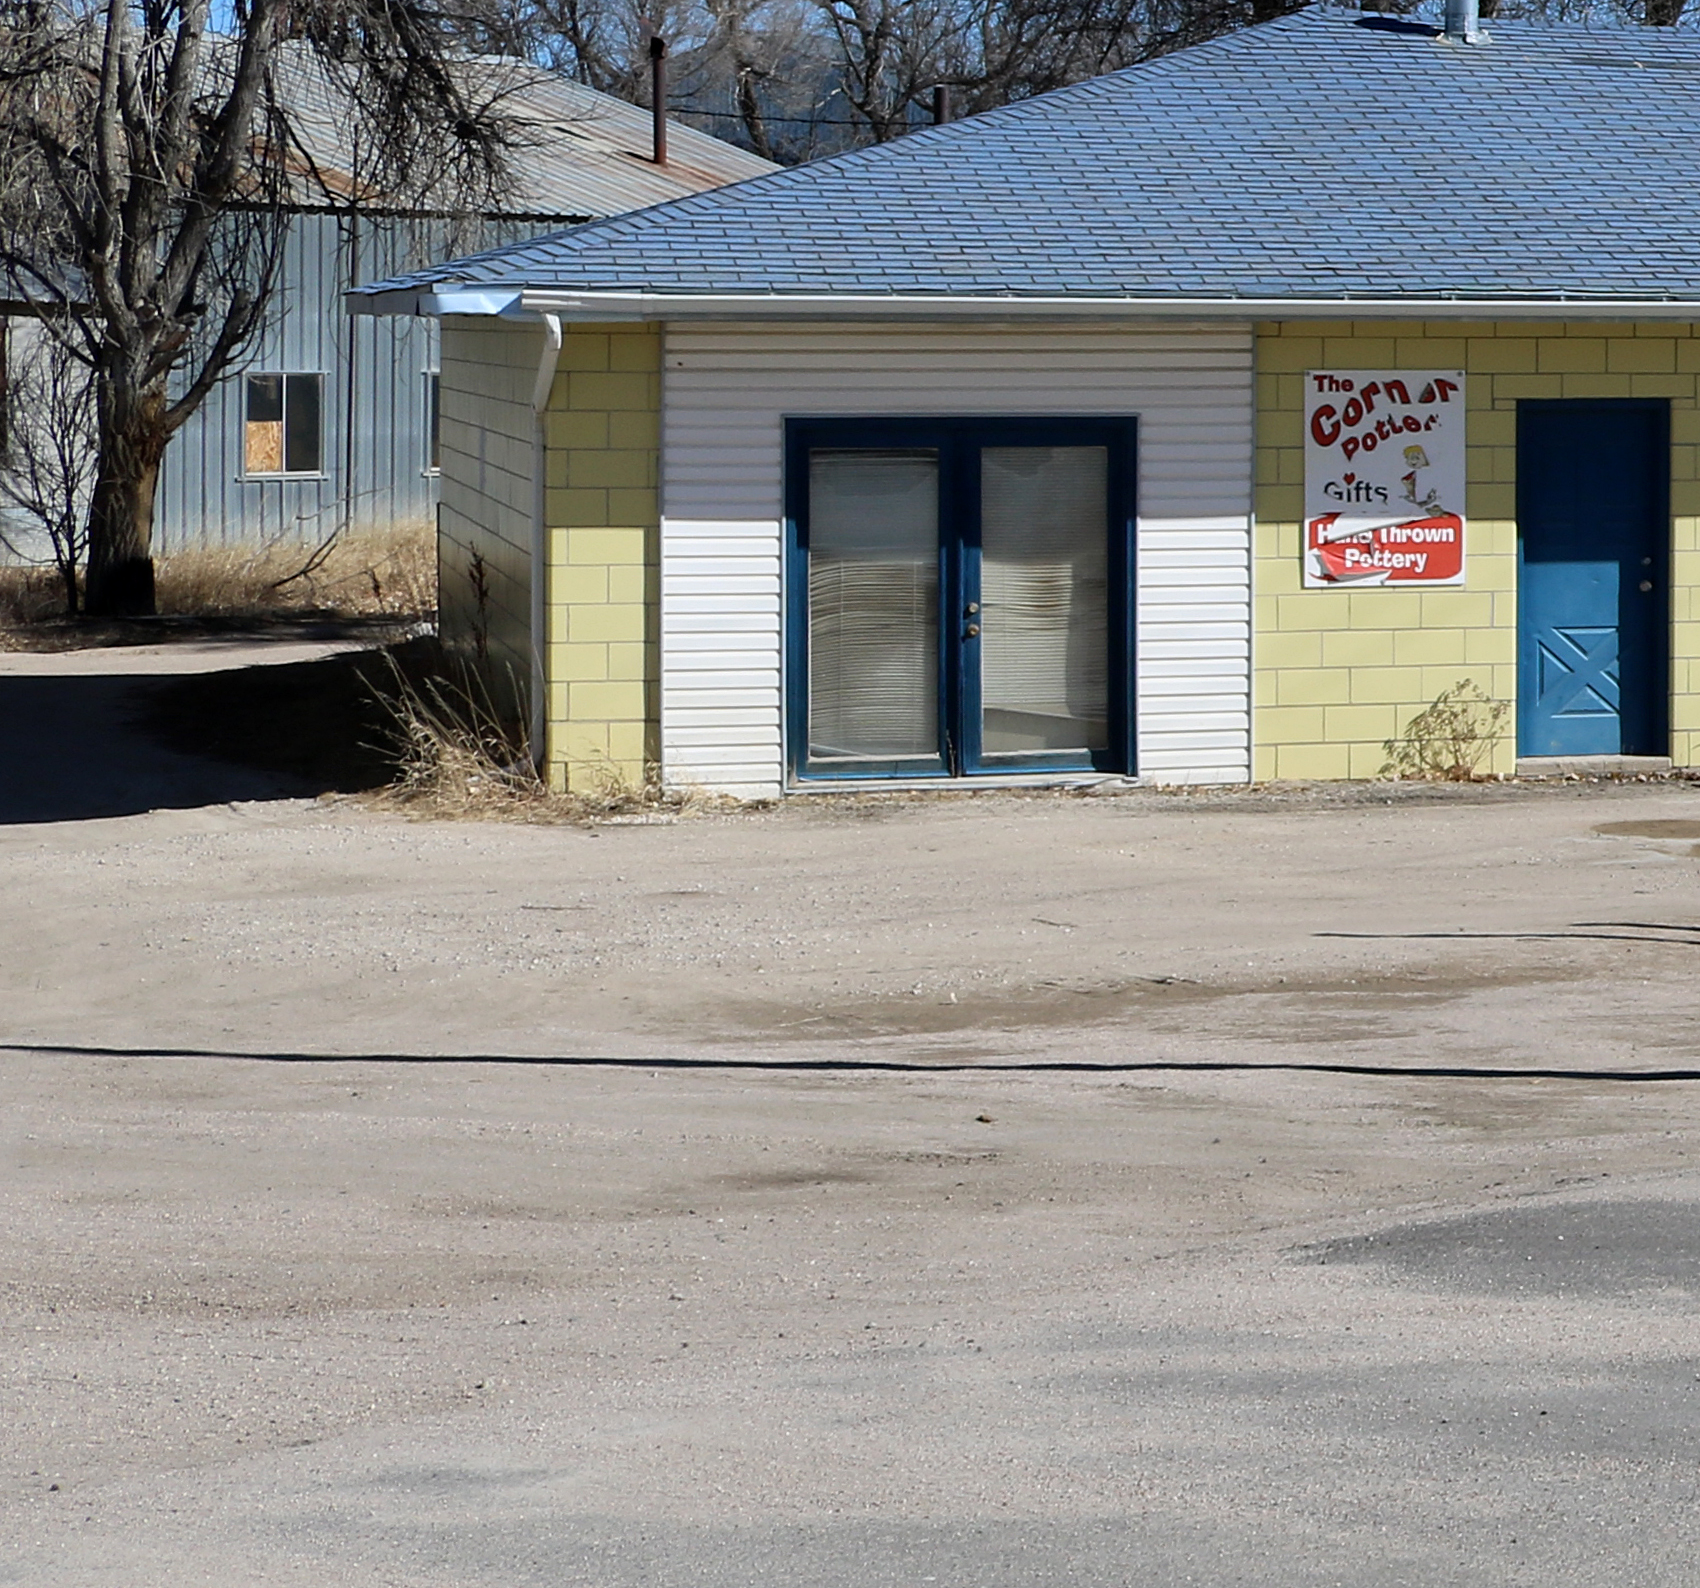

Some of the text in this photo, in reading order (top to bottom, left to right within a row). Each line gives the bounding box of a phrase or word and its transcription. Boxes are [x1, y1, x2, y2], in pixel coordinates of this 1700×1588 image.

[1313, 374, 1354, 392] The
[1324, 478, 1389, 505] Gifts
[1380, 526, 1455, 544] Thrown
[1344, 548, 1429, 574] Pottery
